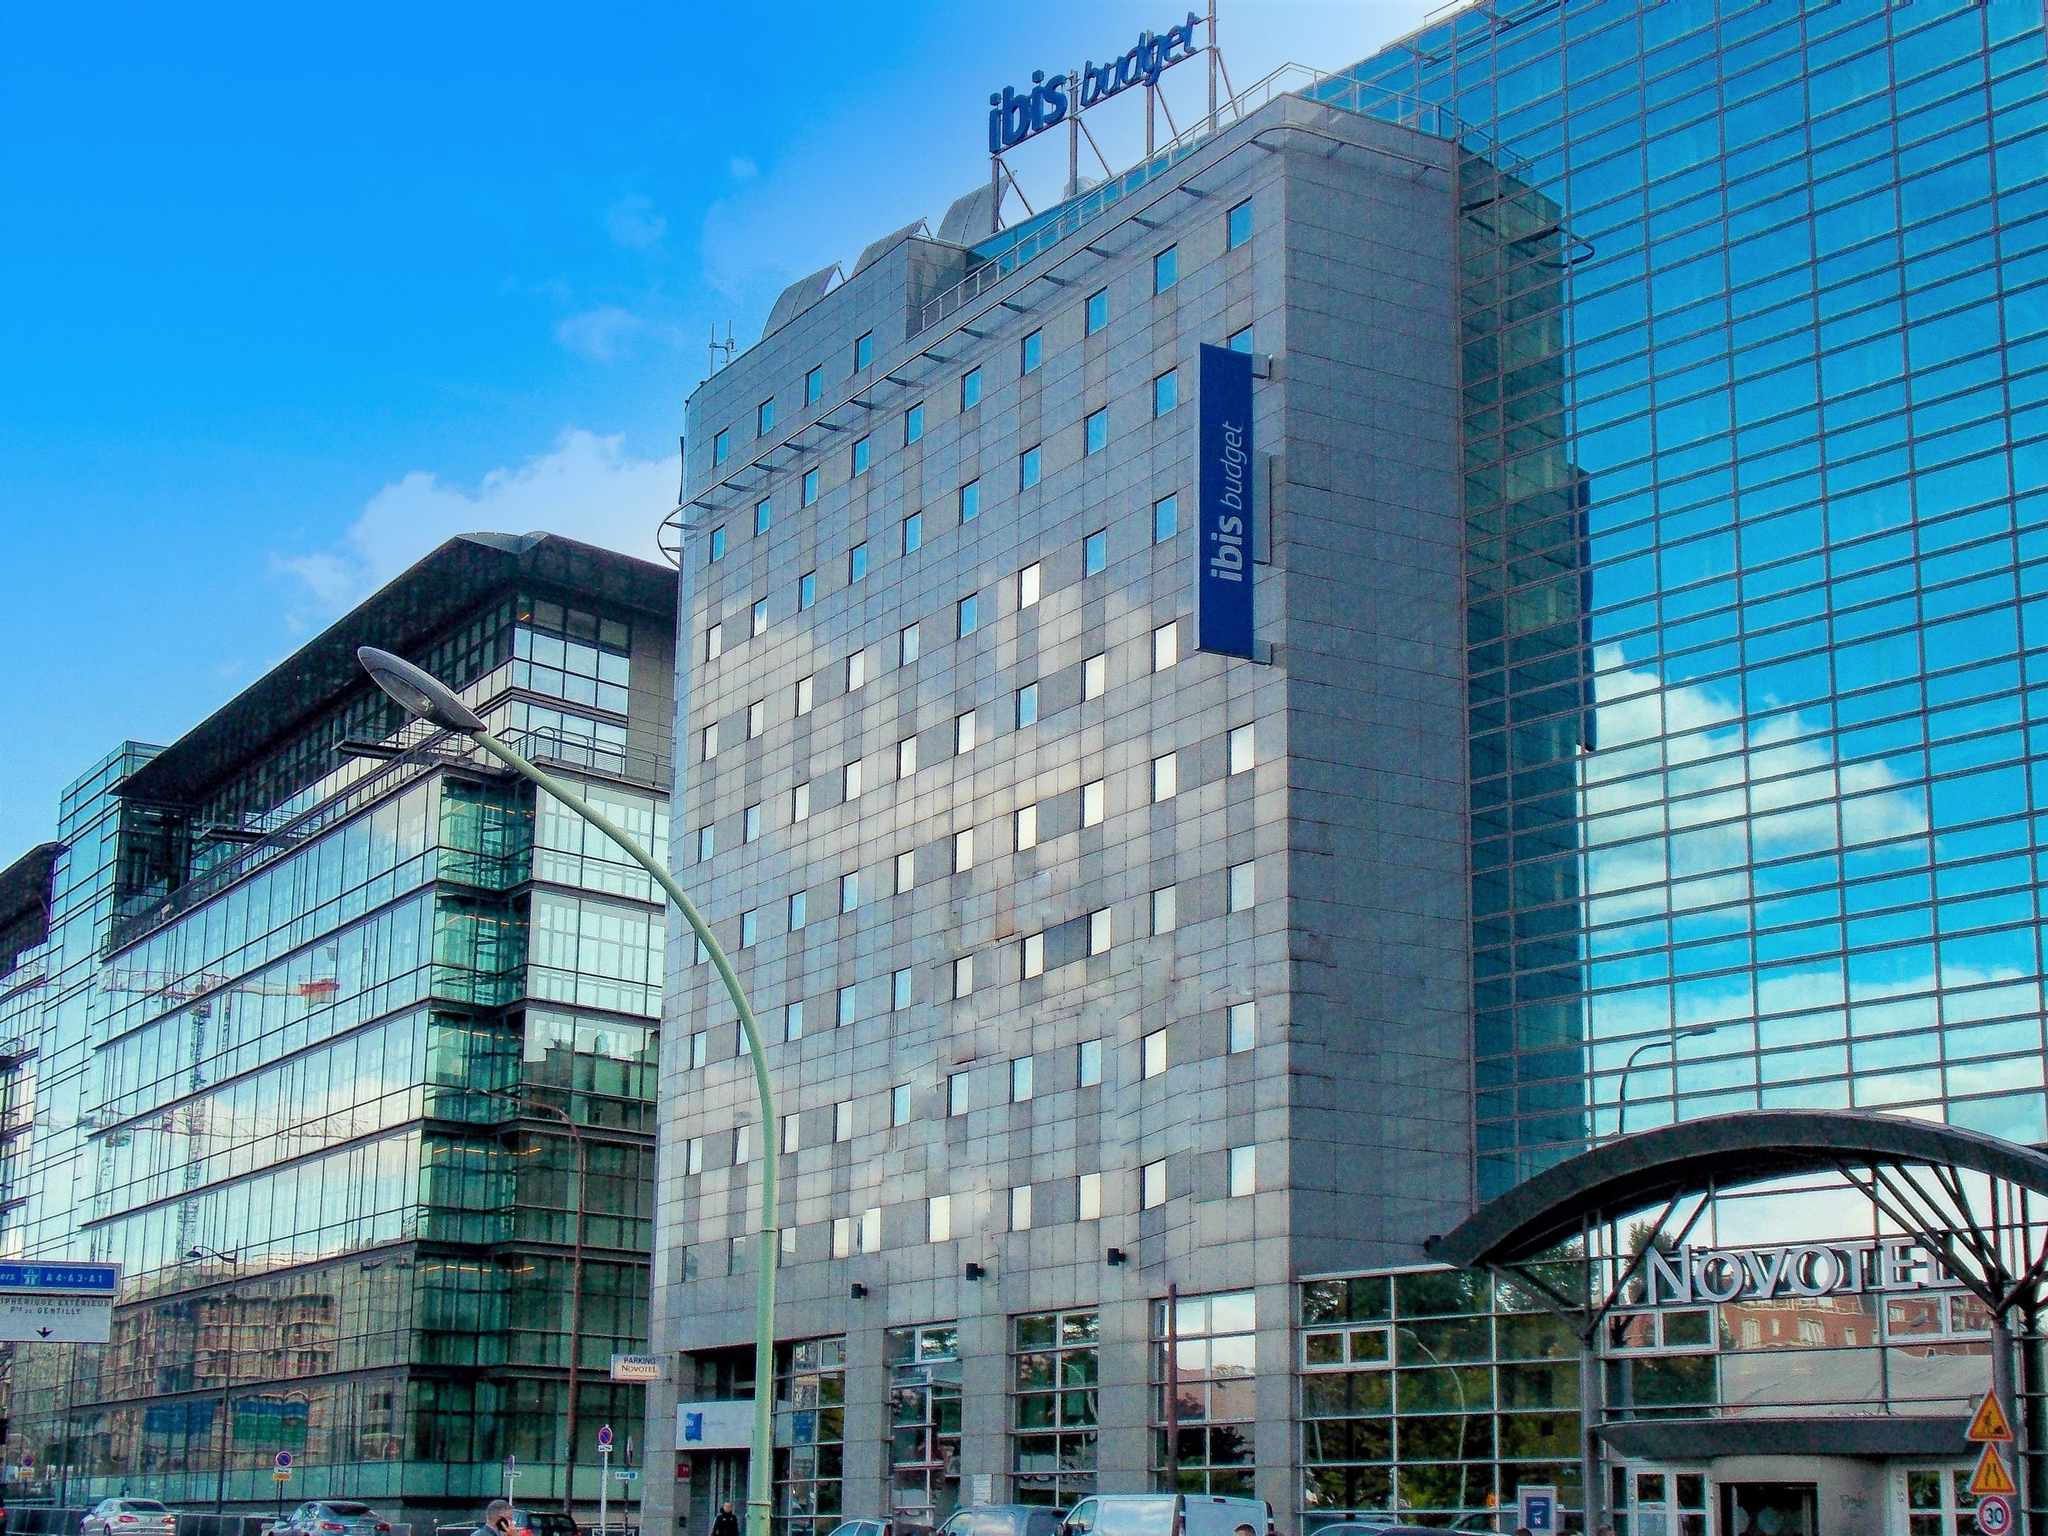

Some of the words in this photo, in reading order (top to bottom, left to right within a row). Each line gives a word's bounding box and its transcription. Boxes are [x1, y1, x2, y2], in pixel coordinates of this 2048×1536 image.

[989, 70, 1068, 153] ibis
[1080, 11, 1200, 107] budget
[1219, 420, 1248, 511] budget
[1210, 515, 1243, 582] ibis
[1648, 1236, 1967, 1305] NOVOTEL
[1986, 1507, 2004, 1525] 30
